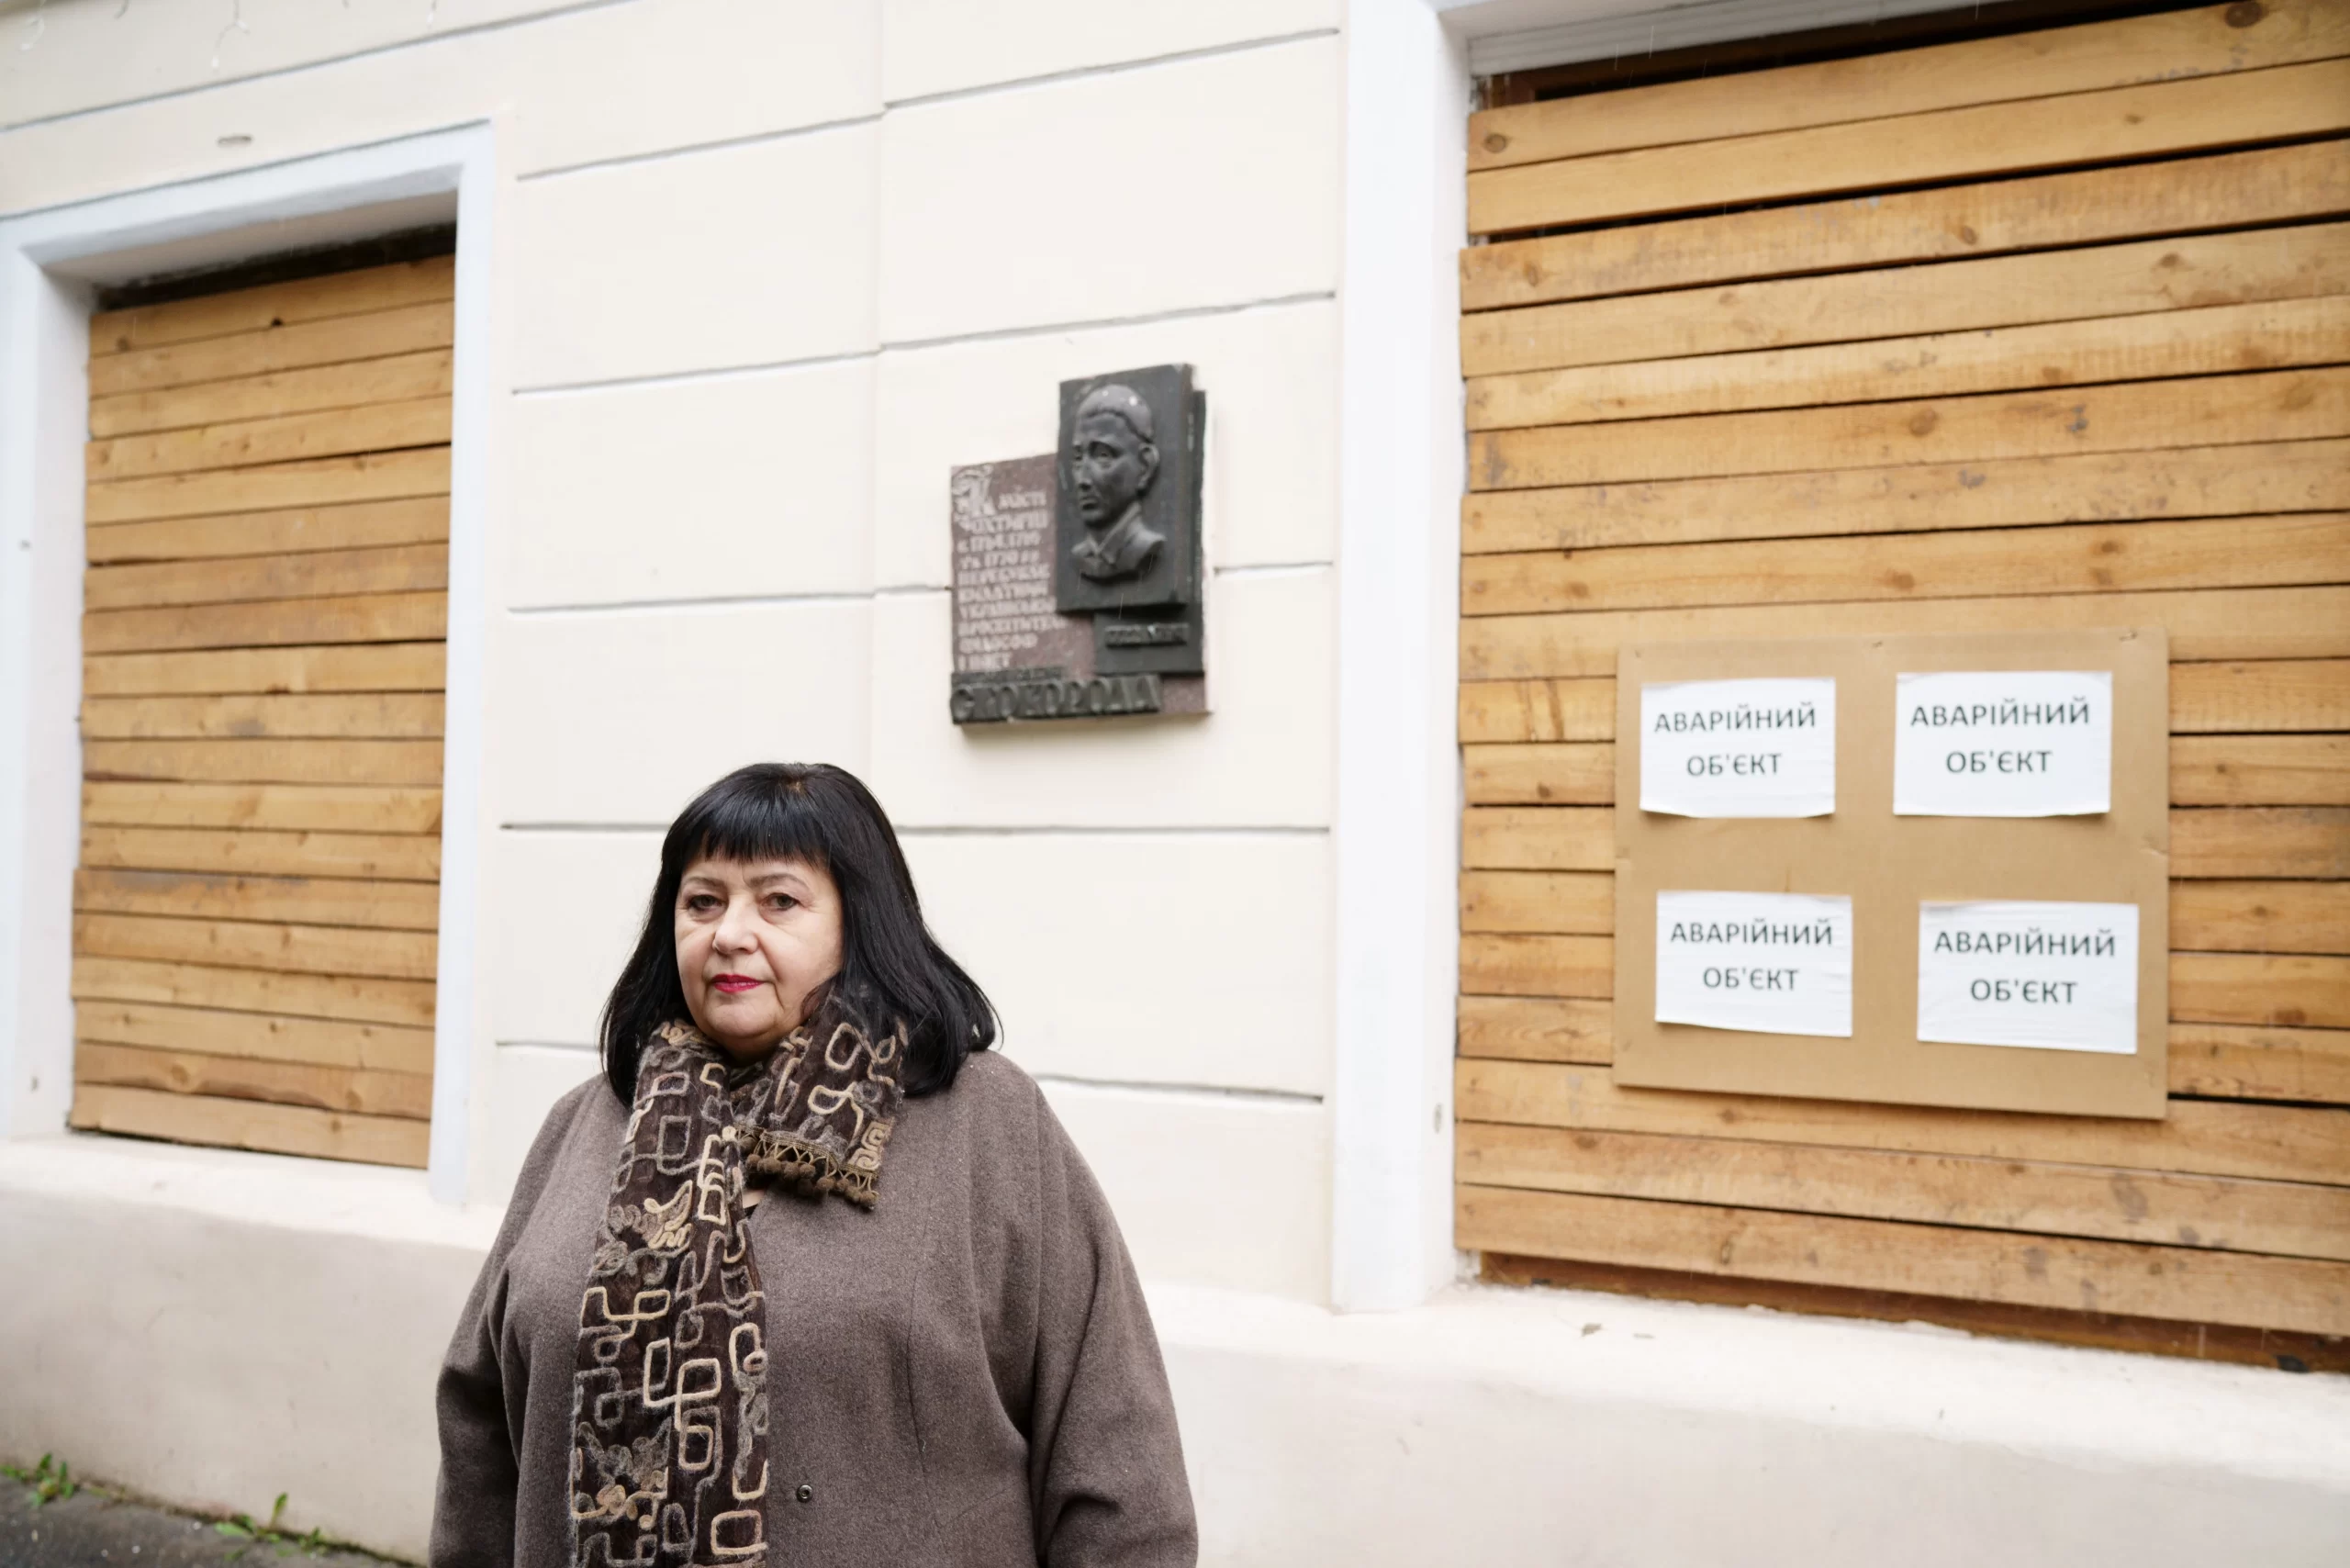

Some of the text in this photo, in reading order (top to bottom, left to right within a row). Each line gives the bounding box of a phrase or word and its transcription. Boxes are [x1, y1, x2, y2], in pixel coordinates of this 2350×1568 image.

[1655, 702, 1815, 733] АВАРІЙНИЙ
[1910, 697, 2089, 727] АВАРІЙНИЙ
[1686, 754, 1782, 776] ОБ'ЄКТ
[1946, 750, 2052, 773] ОБ'ЄКТ
[1671, 918, 1833, 945] АВАРІЙНИЙ
[1934, 928, 2115, 958] АВАРІЙНИЙ
[1703, 968, 1799, 991] ОБ'ЄКТ
[1970, 979, 2078, 1003] ОБ'ЄКТ
